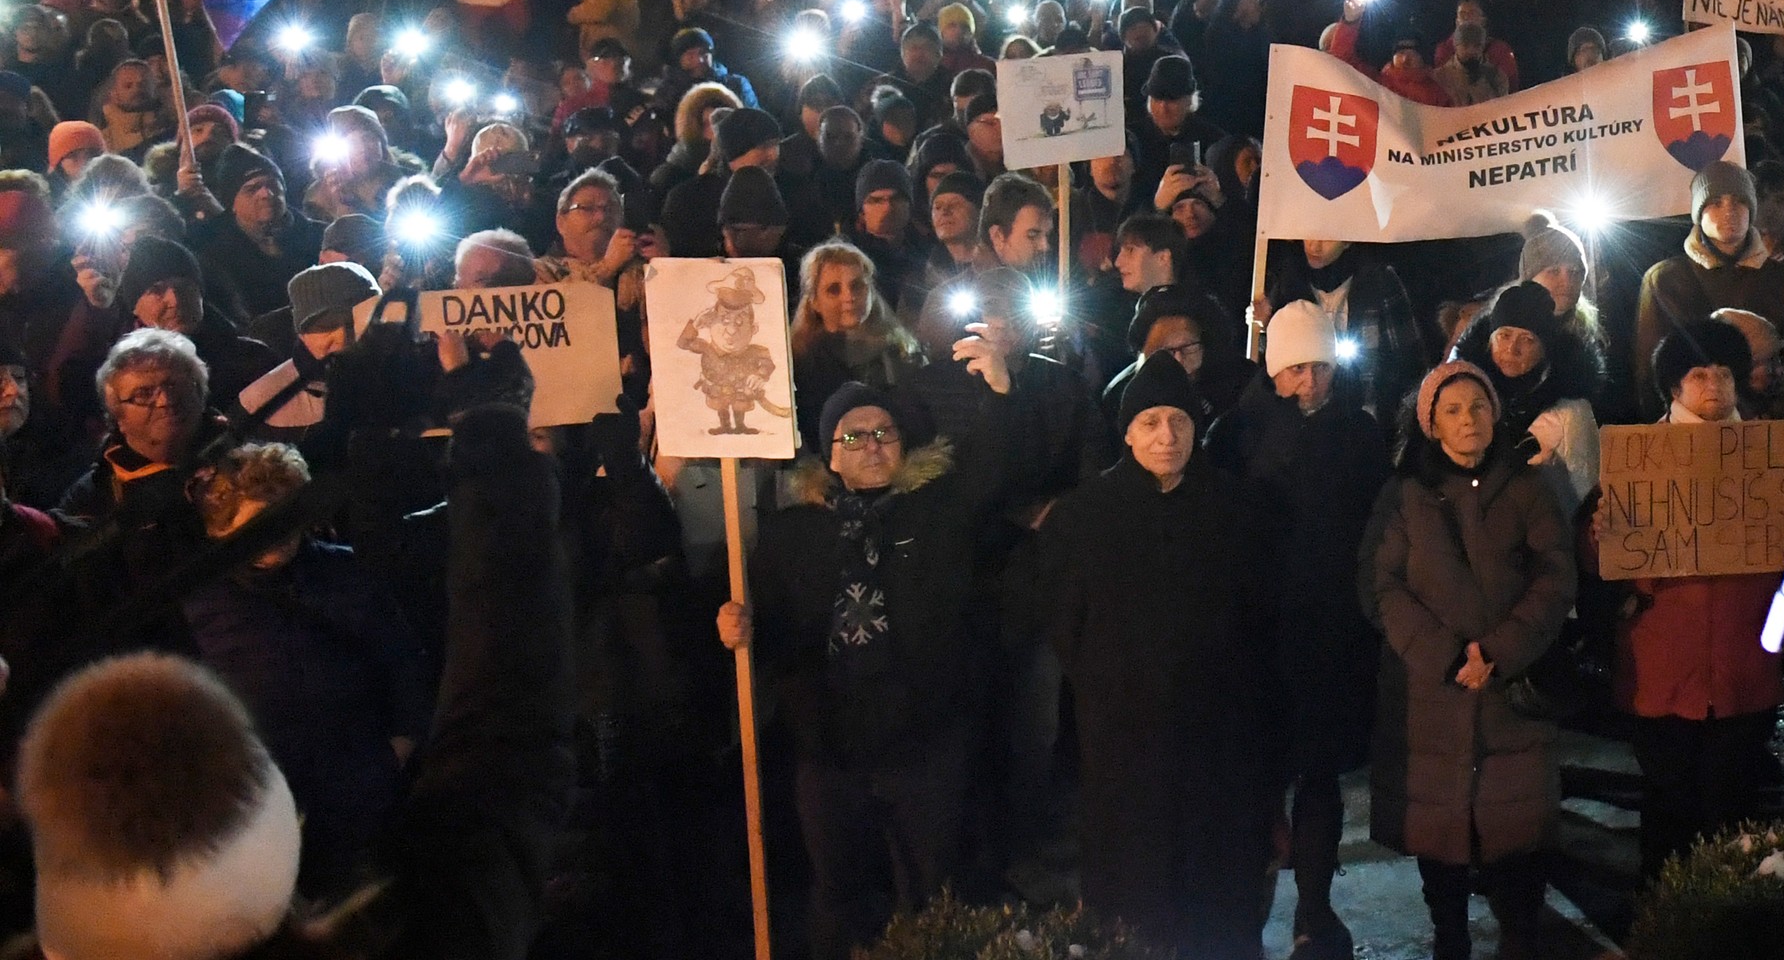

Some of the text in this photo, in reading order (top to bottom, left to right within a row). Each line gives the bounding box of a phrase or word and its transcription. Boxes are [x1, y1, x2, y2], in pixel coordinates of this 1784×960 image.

[1388, 118, 1644, 166] NA MINISTERSTVO KULTÚRY
[1436, 103, 1594, 147] NEKULTÚRA
[1468, 149, 1577, 189] NEPATRÍ
[442, 289, 566, 327] DANKO
